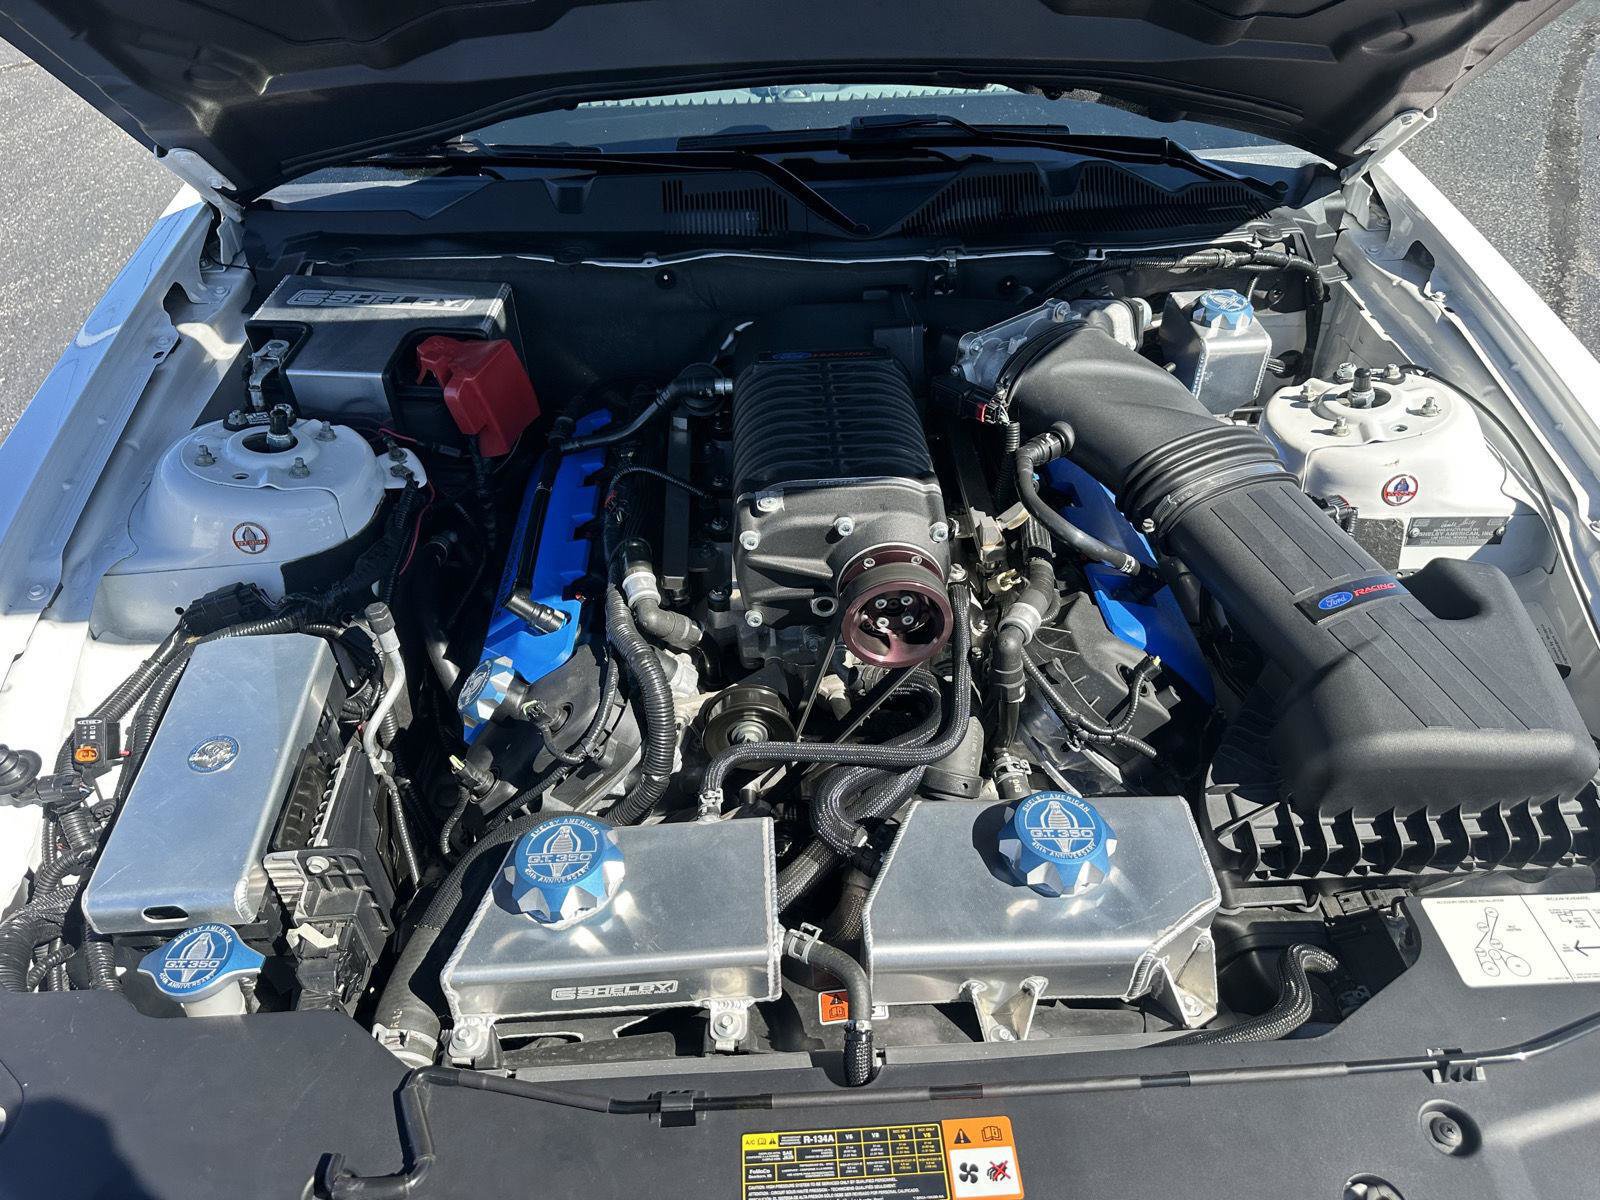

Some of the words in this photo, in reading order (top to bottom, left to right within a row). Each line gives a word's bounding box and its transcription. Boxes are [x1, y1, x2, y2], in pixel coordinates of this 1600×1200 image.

[1353, 582, 1397, 597] RACING
[1022, 793, 1046, 812] SHELBY
[1049, 793, 1090, 813] AMERICAN
[530, 819, 560, 839] SHELBY
[563, 818, 600, 836] AMERICAN
[1059, 829, 1095, 838] 350
[555, 853, 593, 863] 350
[1049, 842, 1097, 860] ANNIVERSARY
[537, 865, 591, 884] ANNIVERSARY
[174, 926, 204, 943] SHELBY
[205, 925, 234, 944] AMERICAN
[188, 960, 221, 968] 350
[168, 971, 217, 989] ANNIVERSARY
[803, 1134, 835, 1144] R-134A
